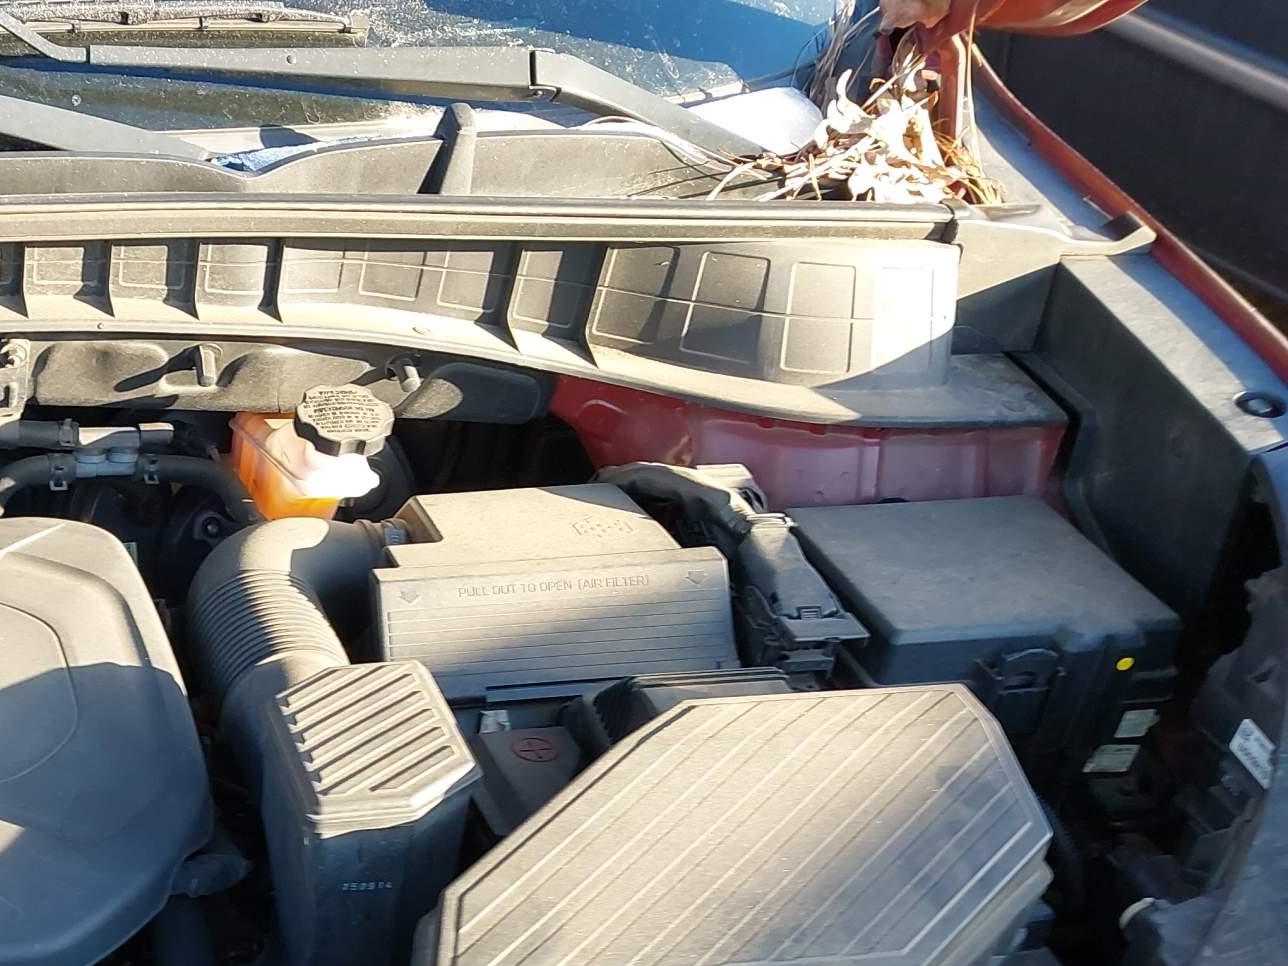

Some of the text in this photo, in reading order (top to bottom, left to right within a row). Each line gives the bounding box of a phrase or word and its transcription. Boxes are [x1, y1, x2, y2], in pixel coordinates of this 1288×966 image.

[457, 586, 489, 598] PULL
[492, 584, 517, 595] OUT
[520, 583, 536, 593] TO
[539, 580, 572, 591] OPEN
